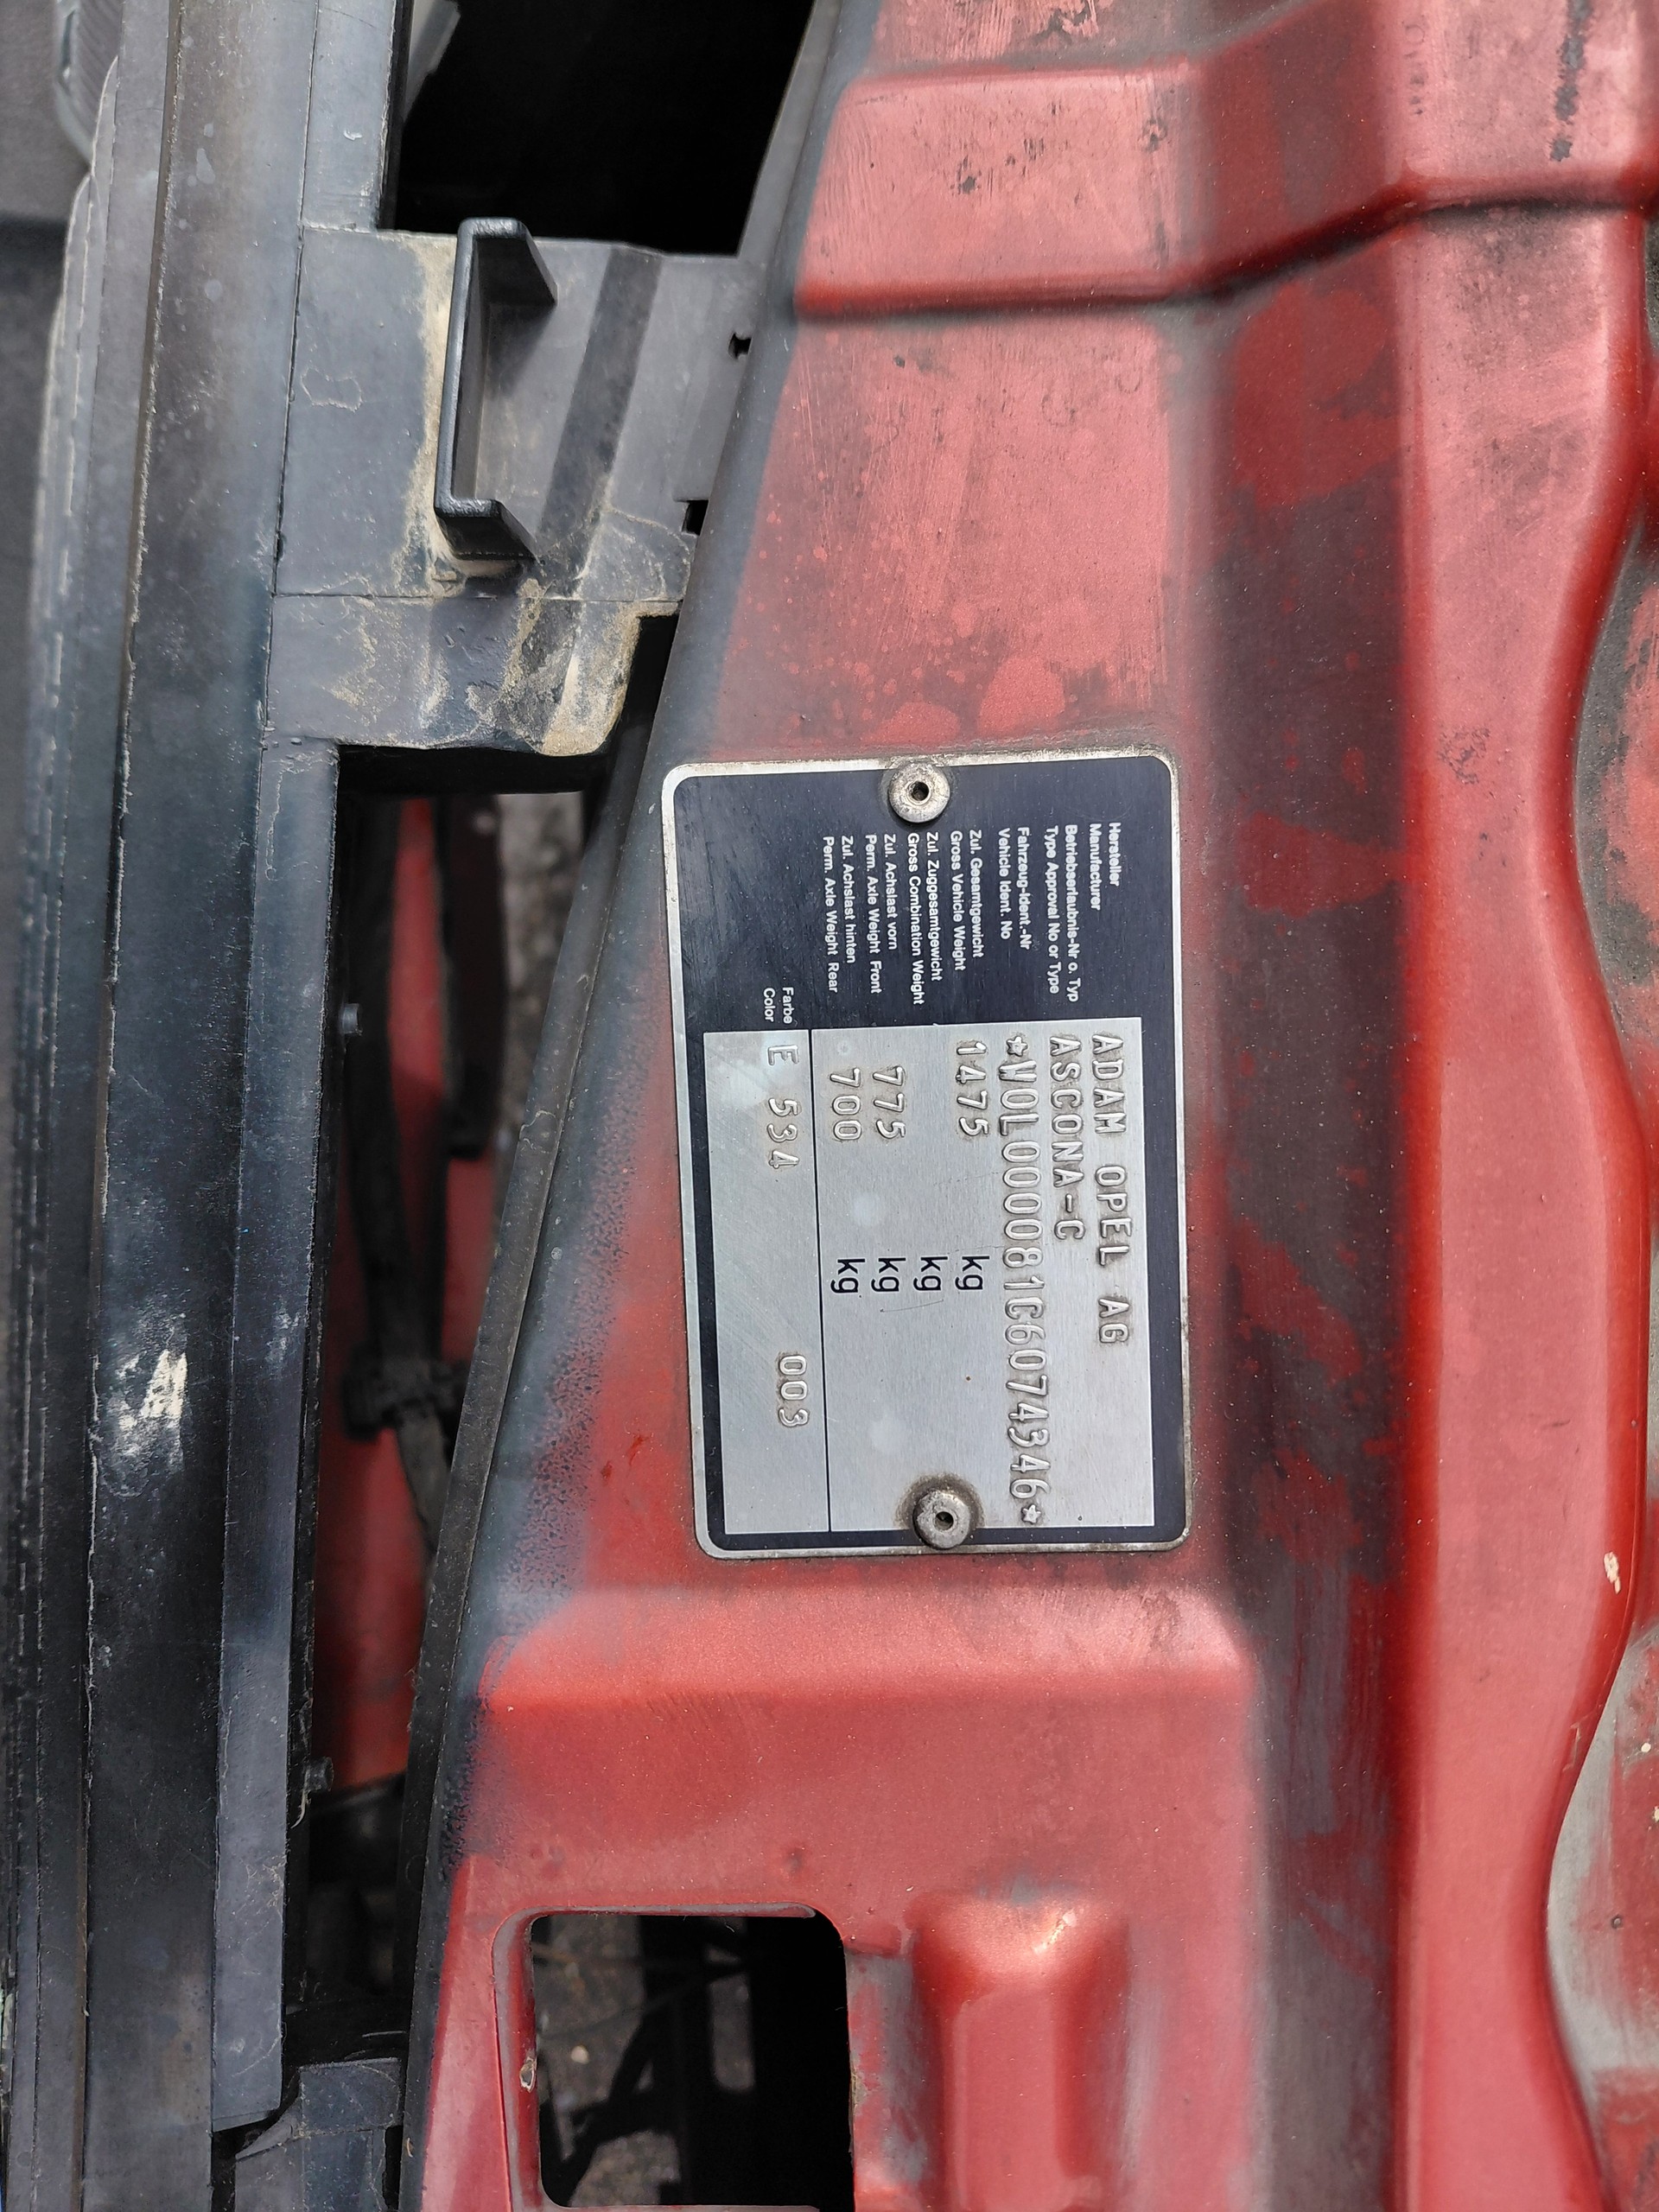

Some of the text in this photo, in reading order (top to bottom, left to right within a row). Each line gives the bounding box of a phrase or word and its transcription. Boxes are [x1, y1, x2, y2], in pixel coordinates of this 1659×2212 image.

[822, 836, 839, 993] Perm. Axle Weight Rear
[840, 836, 856, 963] Zul. Achslast hinten
[864, 835, 882, 994] Perm. Axle Weight Front
[883, 834, 897, 950] Zul. Achslast vorn
[906, 832, 924, 1005] Gross Combination Weight
[925, 831, 942, 982] Zul. Zuggesamtgewicht
[950, 830, 965, 971] Gross Vehicle Weight
[967, 830, 983, 958] Zul. Gesamtgewicht
[997, 828, 1012, 939] Vehicle Ident. No
[1015, 827, 1031, 950] Fahrzeug-Ident.-Nr
[1043, 825, 1060, 994] Type Approval No or Type
[1064, 824, 1080, 1002] Betriebserlaubnis-Nr o. Typ
[1088, 823, 1102, 910] Manufacturer
[1108, 823, 1121, 887] Hersteller
[762, 988, 774, 1022] Color
[781, 987, 793, 1024] Farbe
[829, 1067, 865, 1294] 700 kg
[870, 1065, 906, 1293] 775 kg
[954, 1042, 989, 1291] 1475 kg
[1048, 1036, 1085, 1241] ASCONA-C
[1091, 1034, 1132, 1344] ADAM OPEL AG
[766, 1046, 809, 1428] E 534 003
[912, 1255, 948, 1291] kg
